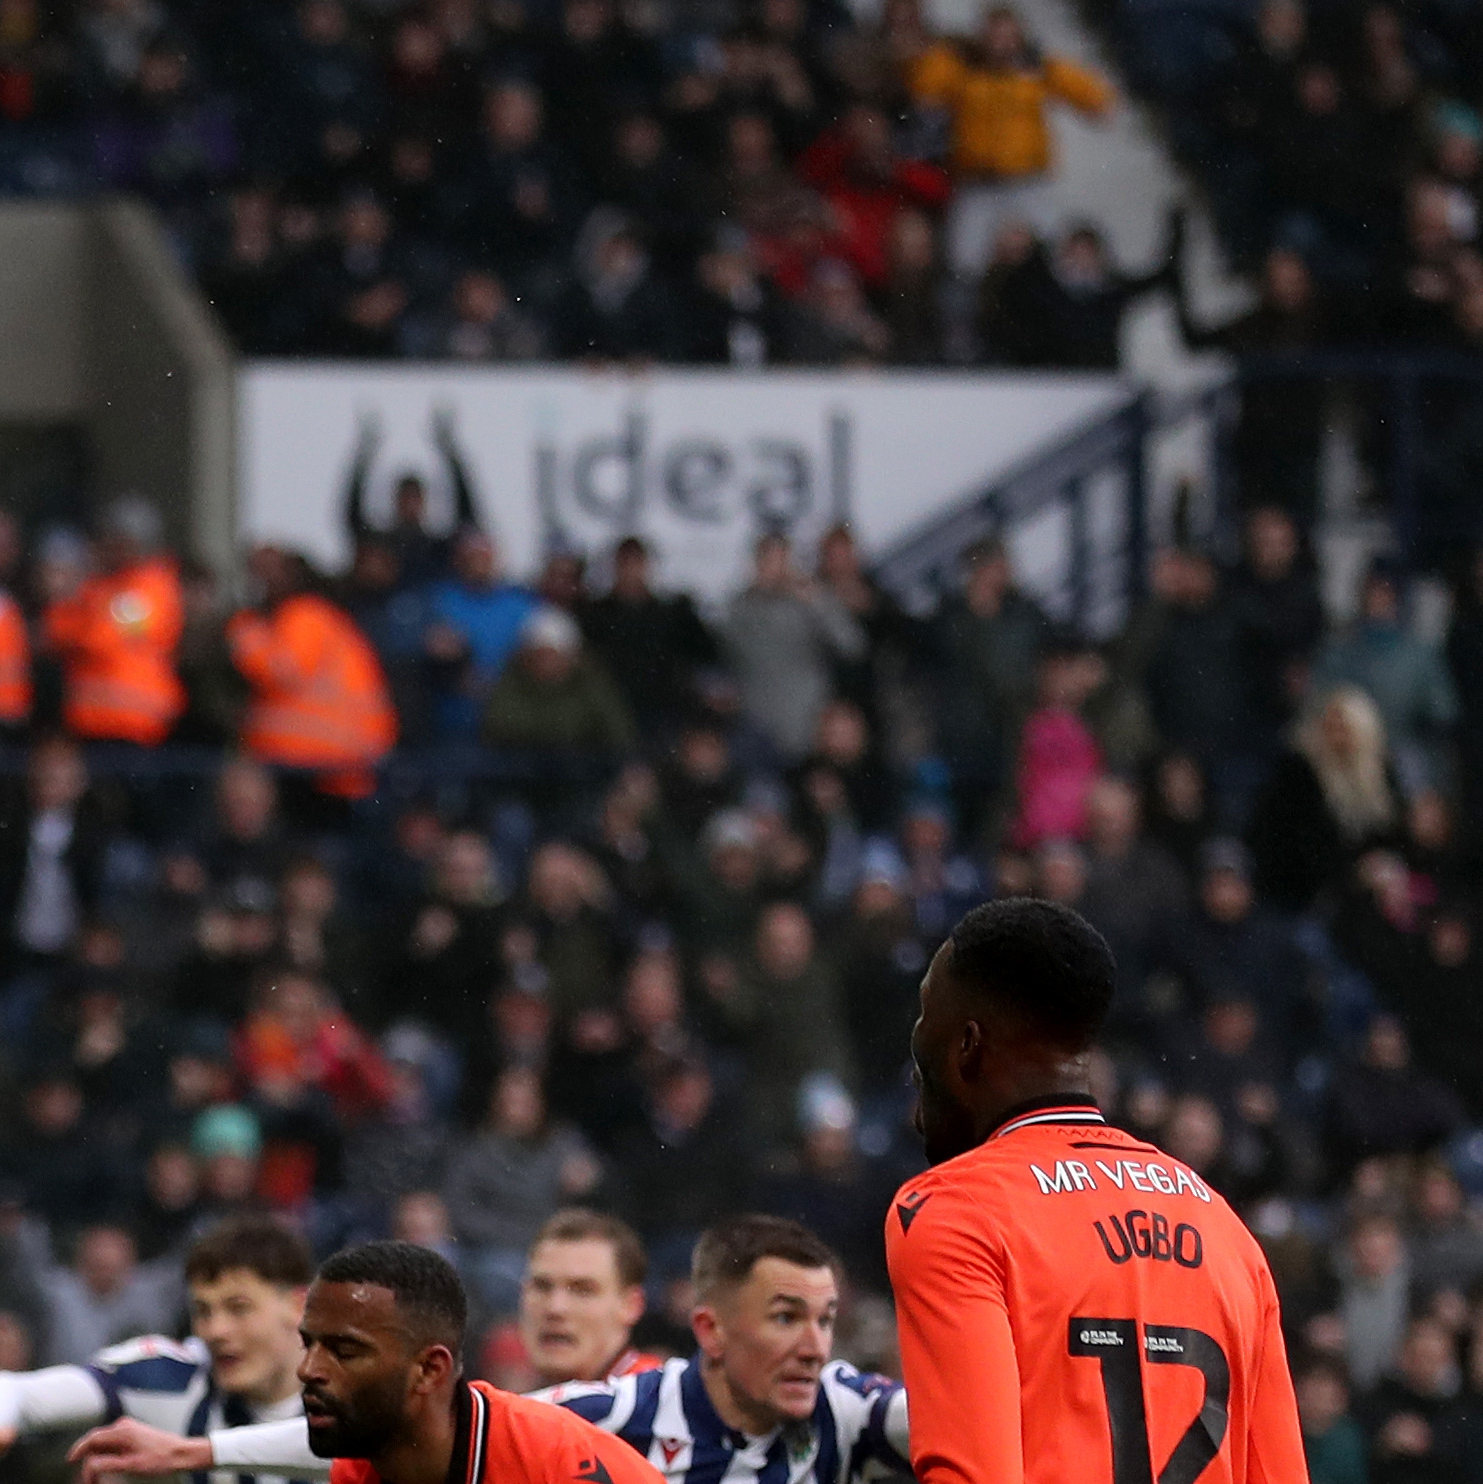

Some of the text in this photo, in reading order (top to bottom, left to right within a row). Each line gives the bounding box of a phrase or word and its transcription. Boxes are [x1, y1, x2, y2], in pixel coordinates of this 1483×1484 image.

[531, 396, 855, 528] ideal
[1029, 1160, 1212, 1203] MR VEGAS
[1093, 1209, 1203, 1269] UGBO
